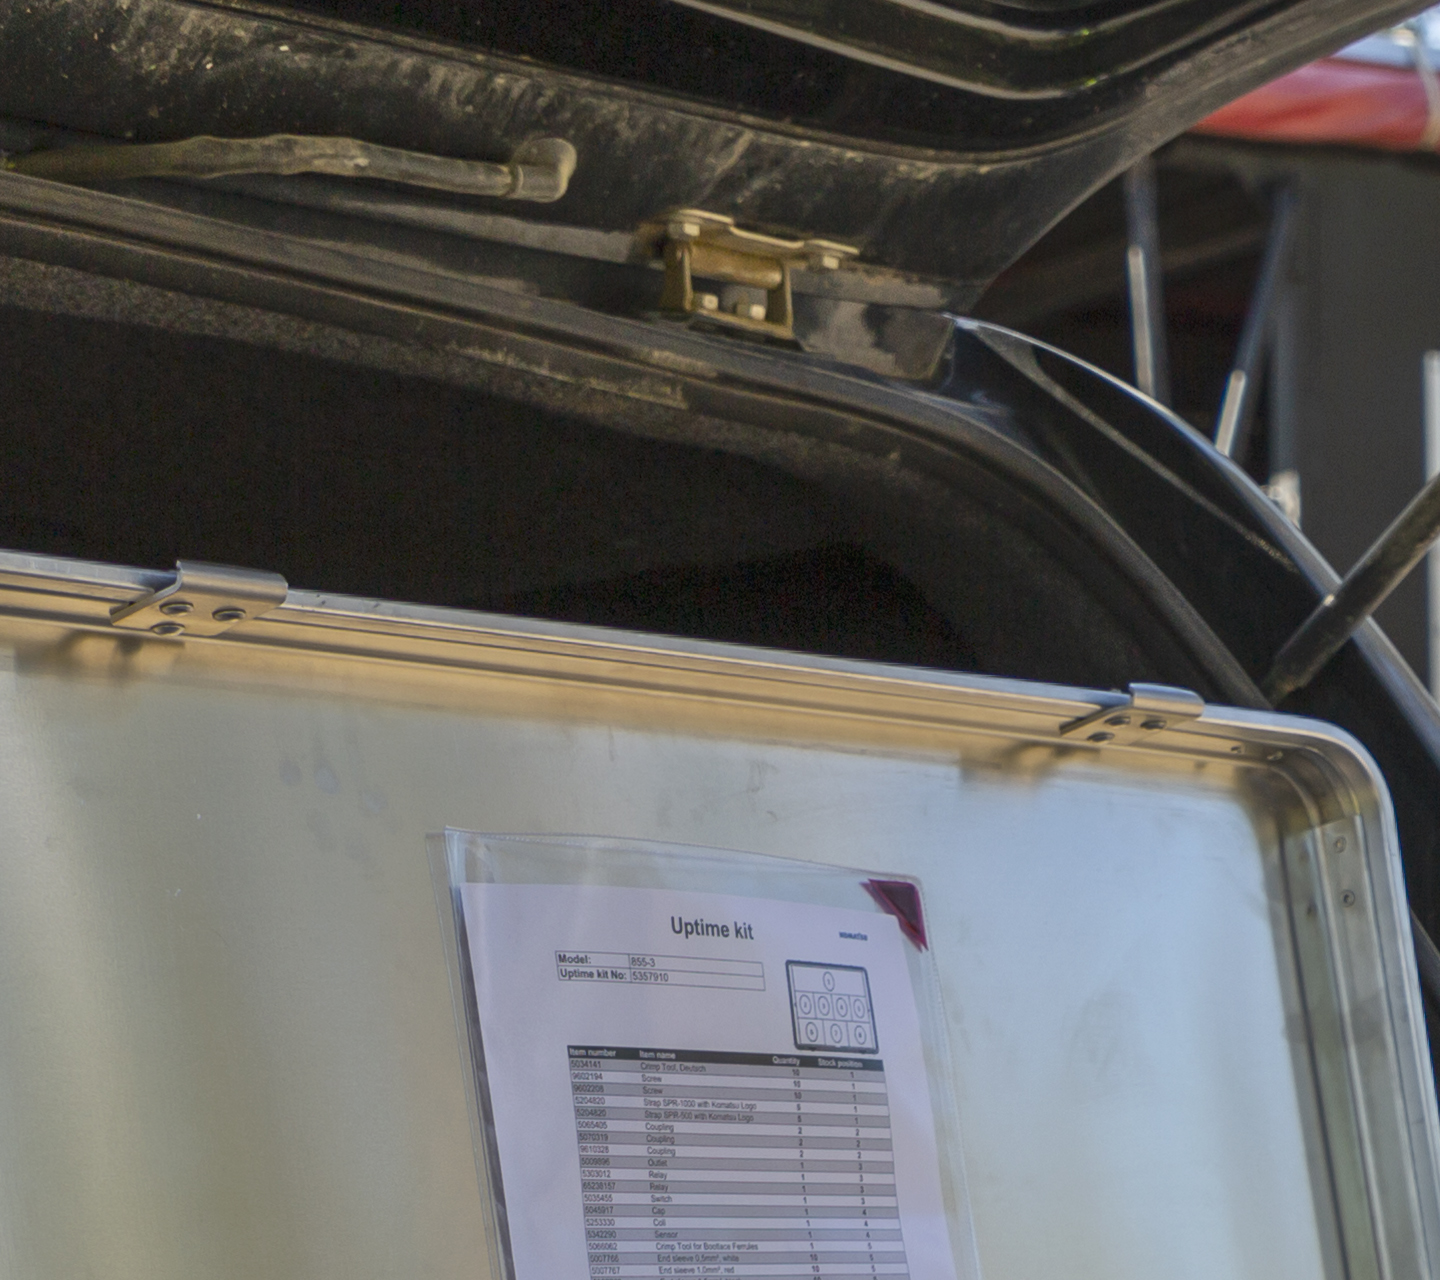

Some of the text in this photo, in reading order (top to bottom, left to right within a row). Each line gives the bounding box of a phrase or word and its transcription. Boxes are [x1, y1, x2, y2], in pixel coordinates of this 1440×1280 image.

[671, 916, 754, 940] Uptime kit
[558, 954, 656, 968] Model: 855-3
[560, 968, 669, 982] Uptime kit No: 5357910
[569, 1048, 586, 1056] Item
[588, 1049, 616, 1057] number
[639, 1050, 655, 1058] Item
[772, 1055, 800, 1067] Quantity
[818, 1058, 836, 1066] Stock
[837, 1060, 863, 1068] position
[641, 1073, 662, 1082] Screw
[642, 1085, 663, 1094] Screw
[643, 1098, 662, 1108] Strap
[741, 1102, 756, 1111] Logo
[644, 1109, 662, 1120] Strap
[737, 1113, 754, 1123] Logo
[645, 1122, 674, 1132] Coupling
[646, 1133, 675, 1144] Coupling
[646, 1145, 676, 1156] Coupling
[647, 1157, 668, 1167] Outlet
[648, 1169, 667, 1180] Relay
[649, 1181, 668, 1192] Relay
[650, 1194, 672, 1203] Switch
[654, 1229, 678, 1239] Sensor
[677, 1241, 692, 1250] Tool
[693, 1242, 702, 1250] for
